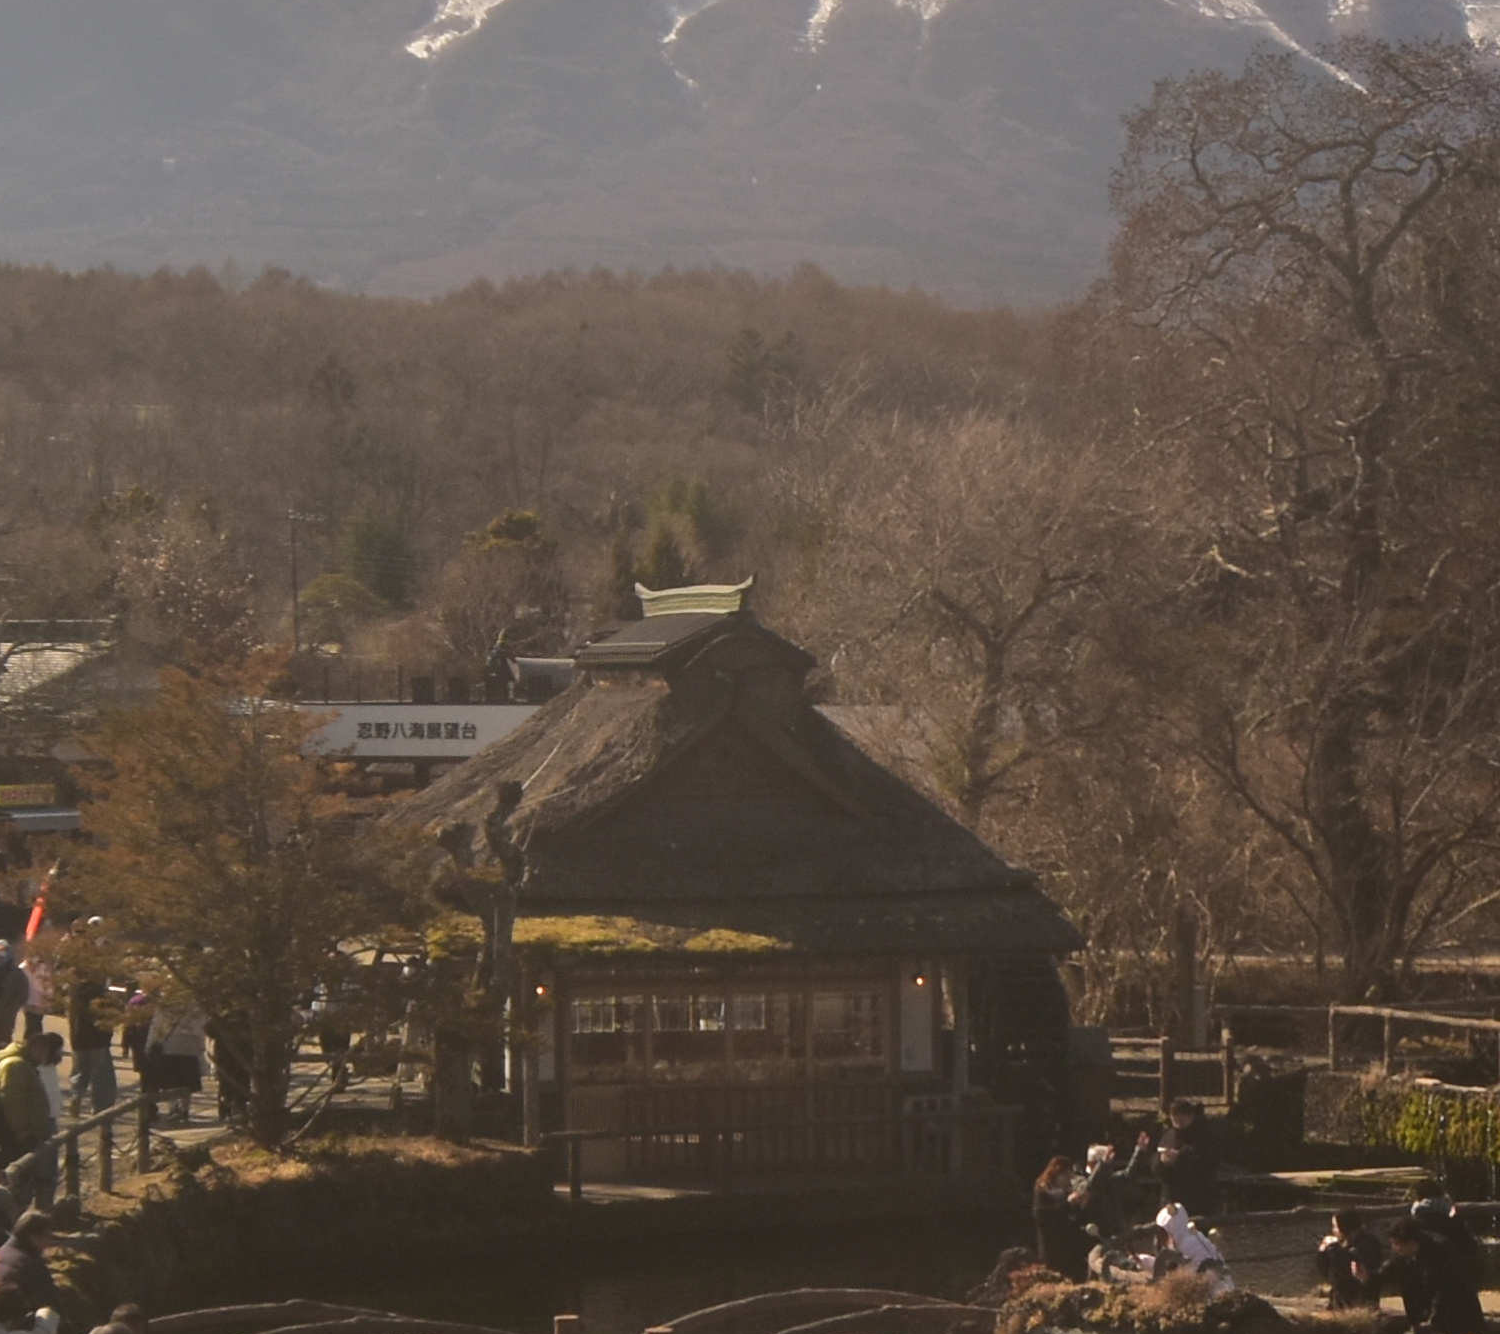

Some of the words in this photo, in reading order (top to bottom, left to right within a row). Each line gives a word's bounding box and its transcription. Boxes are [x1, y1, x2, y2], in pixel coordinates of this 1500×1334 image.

[357, 722, 477, 740] 忍野八海展望台
